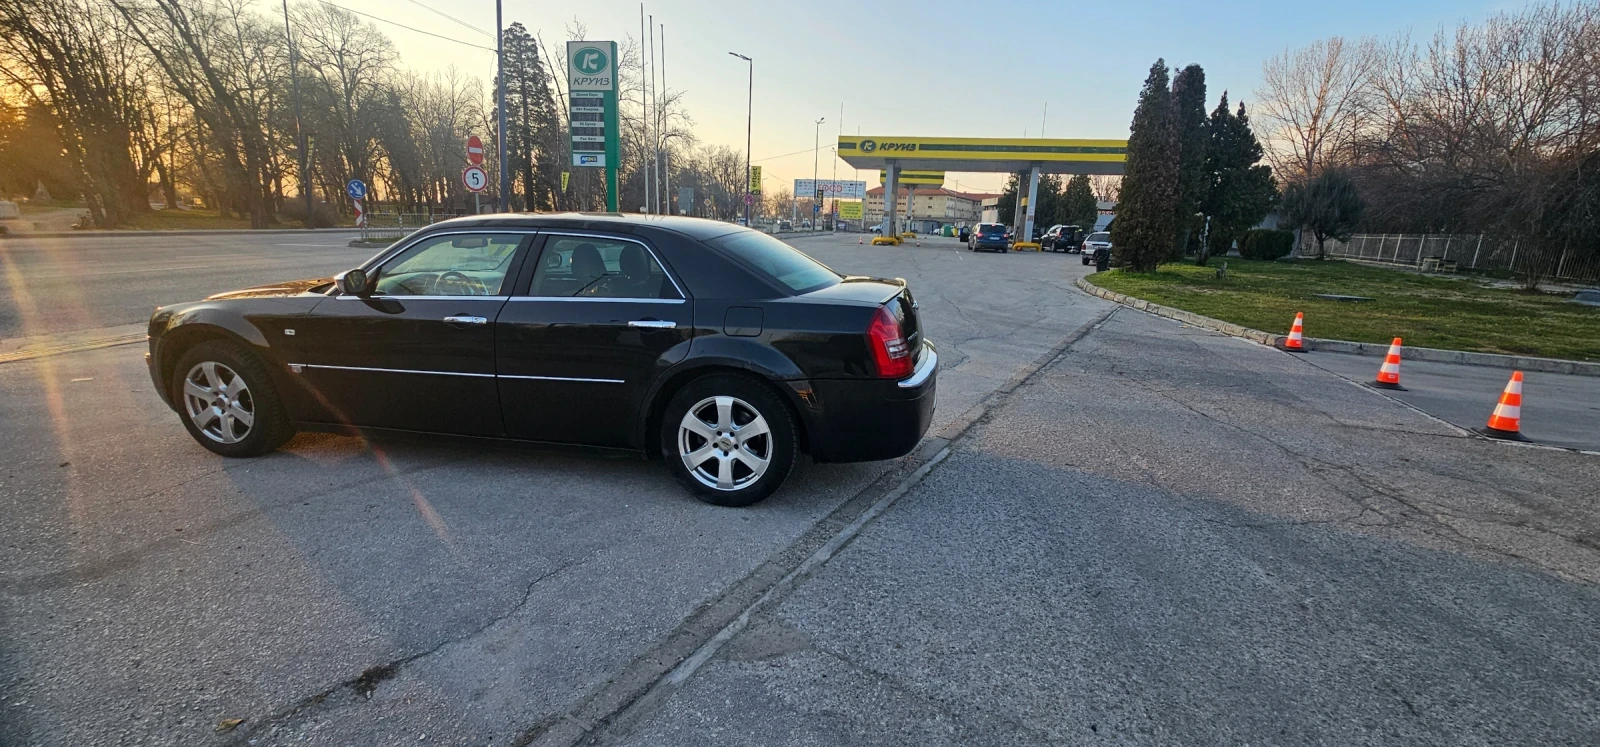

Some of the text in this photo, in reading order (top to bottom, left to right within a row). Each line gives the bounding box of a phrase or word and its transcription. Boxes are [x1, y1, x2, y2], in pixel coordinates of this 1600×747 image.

[573, 77, 610, 86] КРУИЗ
[879, 142, 917, 152] КРУИЗ
[472, 172, 479, 185] 5
